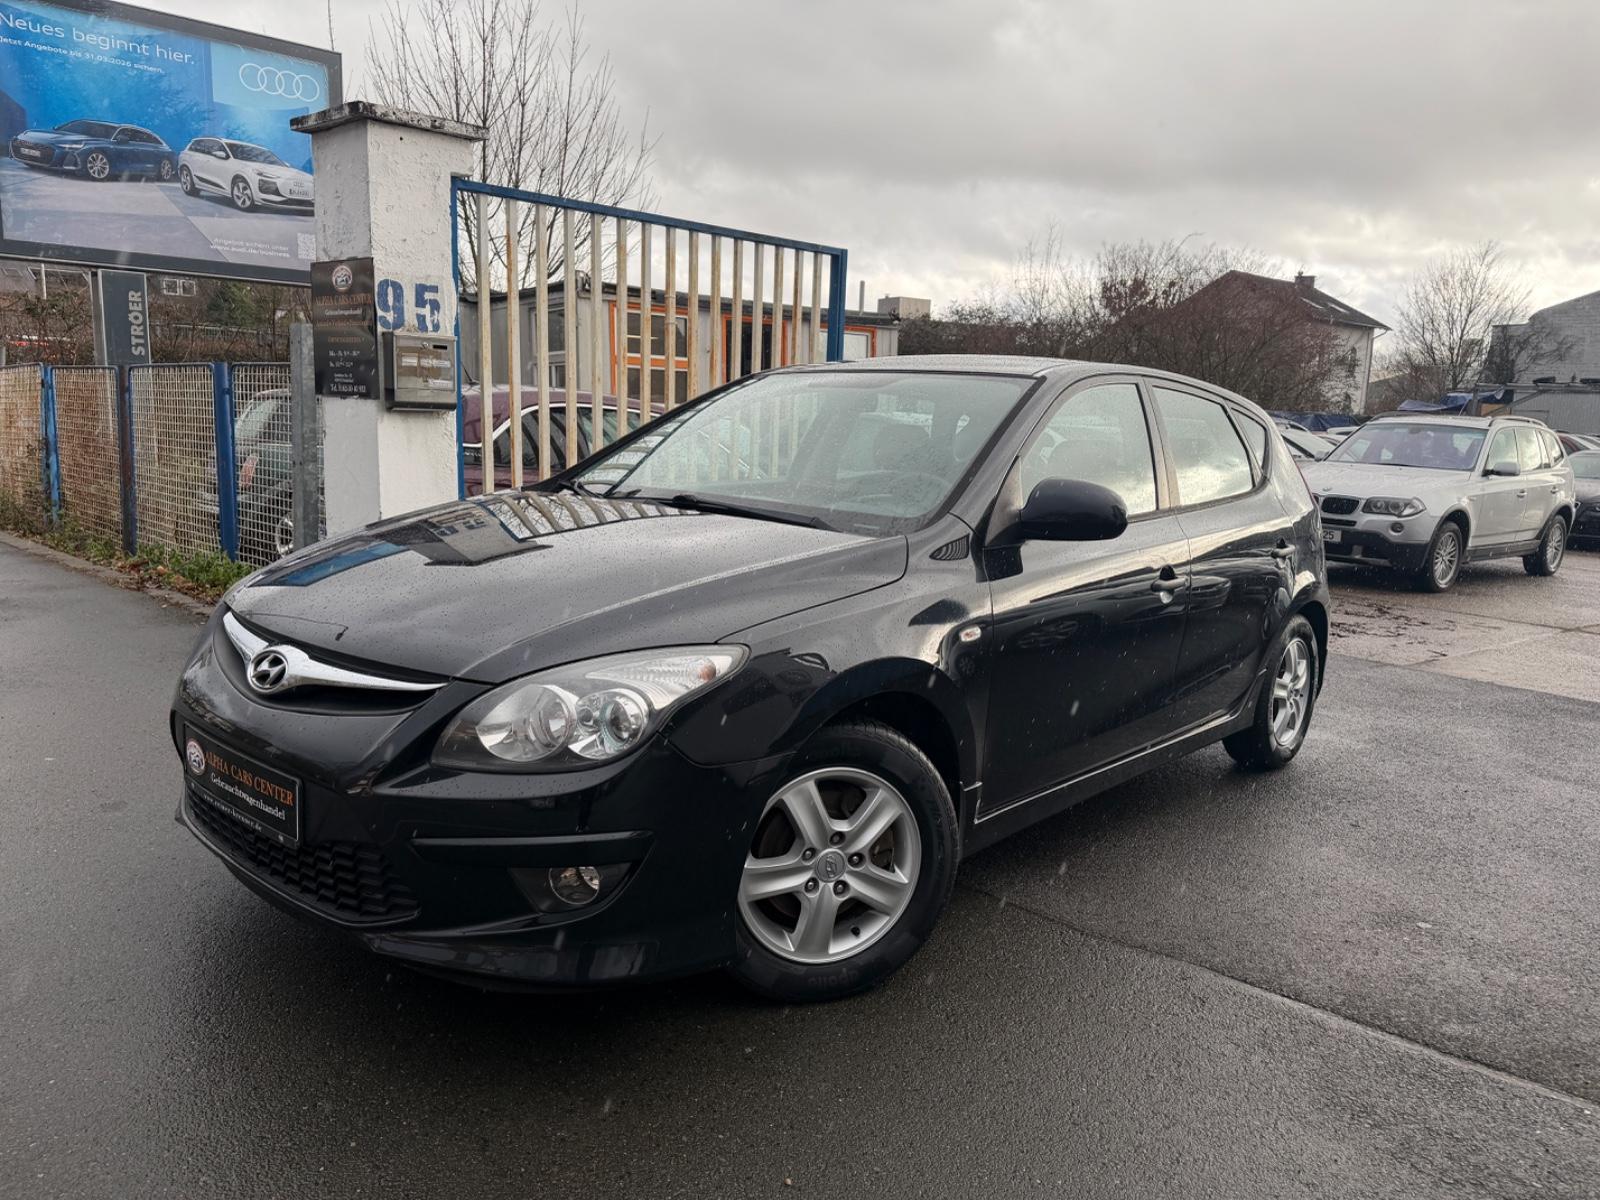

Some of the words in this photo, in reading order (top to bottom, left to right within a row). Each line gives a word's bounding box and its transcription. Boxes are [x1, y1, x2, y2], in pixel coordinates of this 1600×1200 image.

[0, 12, 65, 38] Neues
[72, 27, 149, 56] beginnt
[156, 44, 195, 65] hier.
[24, 40, 68, 55] Angebote
[70, 50, 82, 58] bis
[127, 289, 145, 356] STRÖER
[377, 278, 441, 334] 95
[1322, 530, 1335, 540] 25
[204, 751, 230, 775] ALPHA
[231, 764, 253, 787] CARS
[254, 776, 294, 806] CENTER
[211, 772, 286, 821] Gebrauchtwagenhandel
